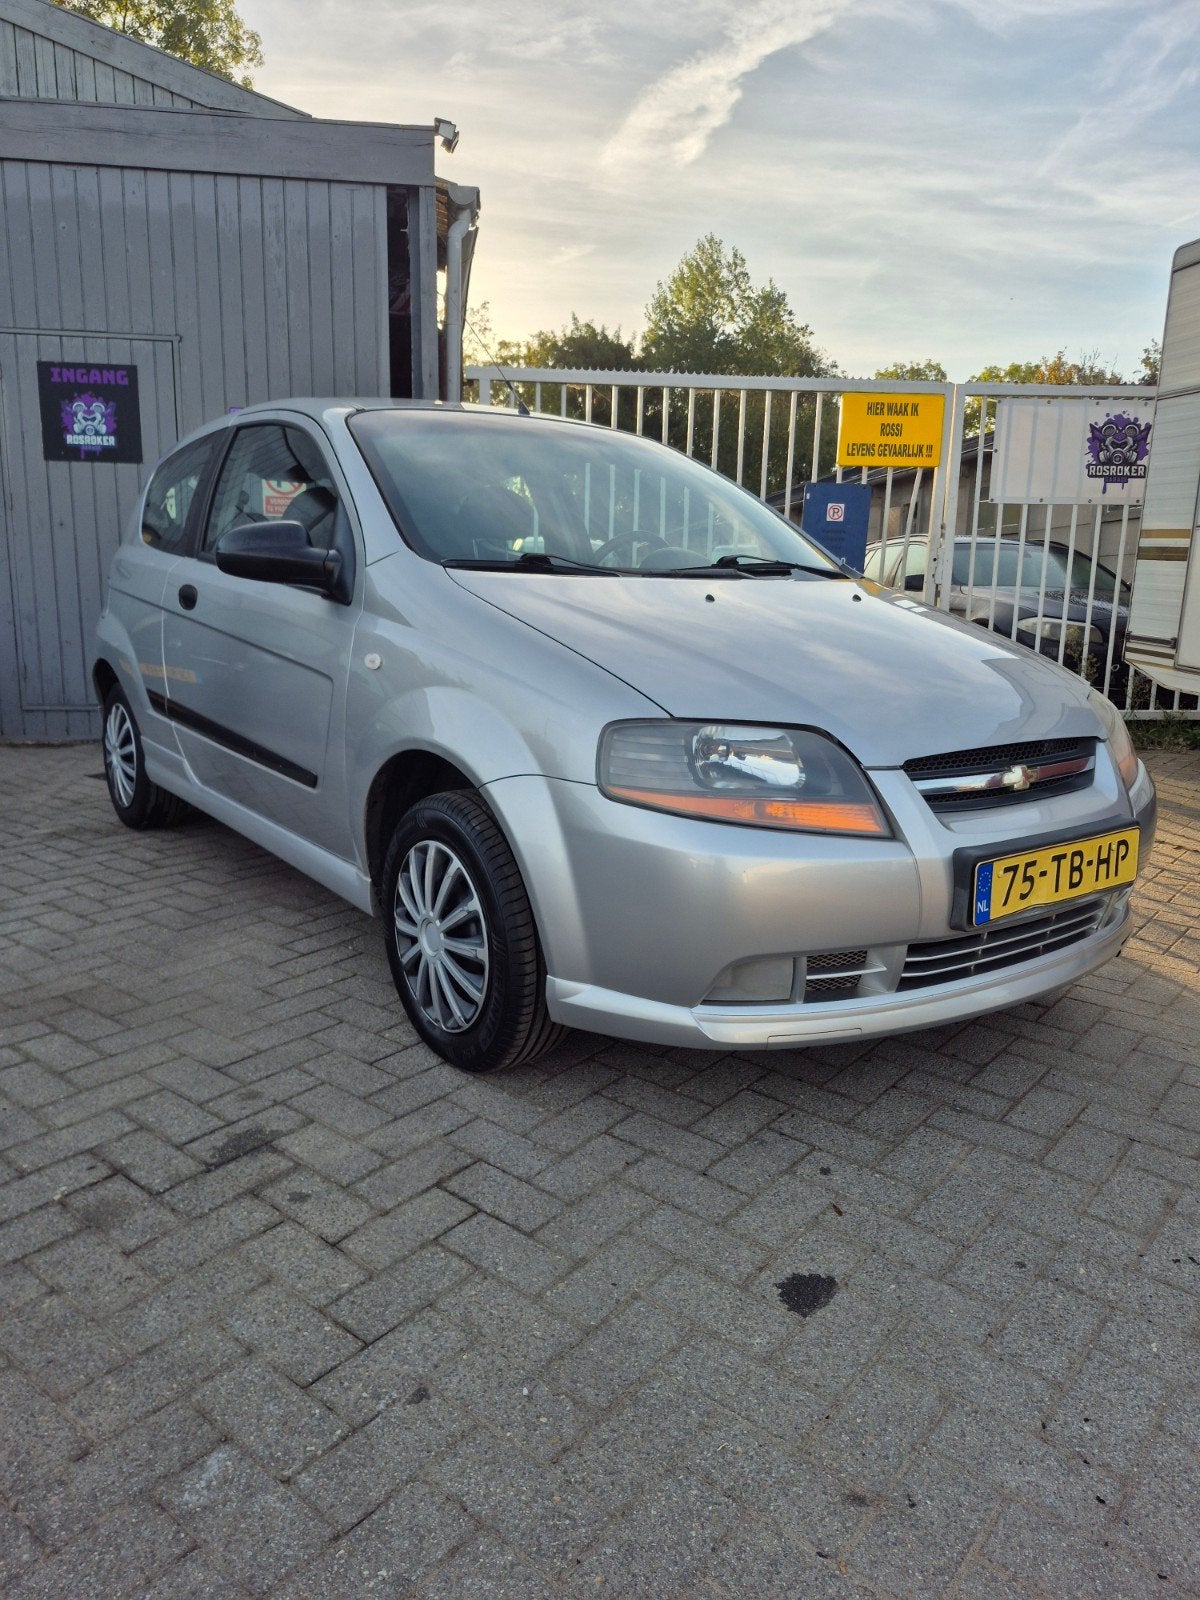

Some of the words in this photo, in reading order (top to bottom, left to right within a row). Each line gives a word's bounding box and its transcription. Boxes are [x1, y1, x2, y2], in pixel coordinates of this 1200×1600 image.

[50, 367, 129, 385] INGANG
[866, 402, 885, 416] HIER
[887, 402, 909, 416] WAAK
[911, 402, 919, 416] IK
[880, 422, 903, 437] ROSSI
[66, 434, 115, 446] ROSROKER
[847, 443, 876, 457] LEVENS
[878, 443, 924, 458] GEVAARLIJK
[1089, 465, 1145, 476] ROSROKER
[1002, 839, 1129, 907] 75-TB-HP
[977, 901, 989, 914] NL
